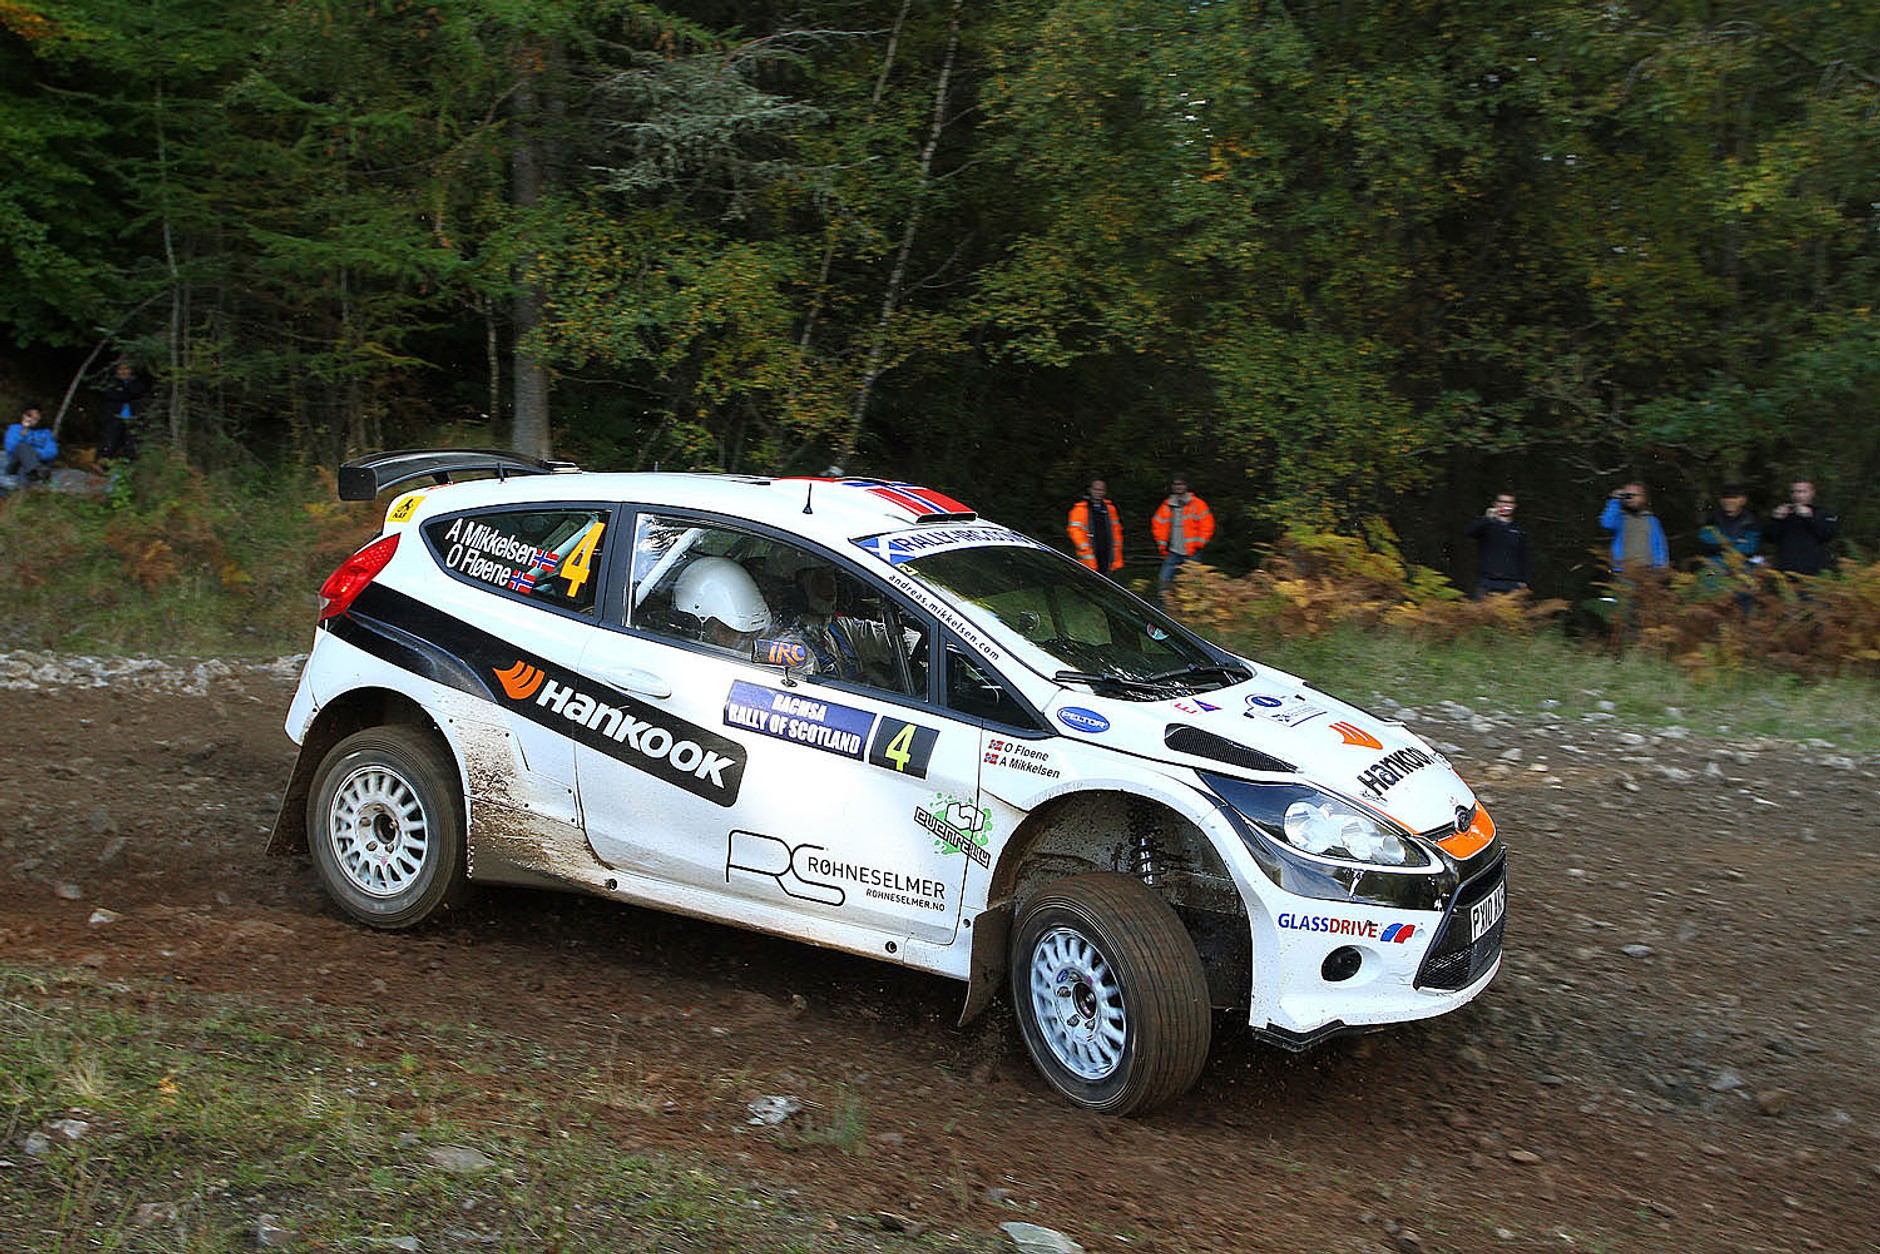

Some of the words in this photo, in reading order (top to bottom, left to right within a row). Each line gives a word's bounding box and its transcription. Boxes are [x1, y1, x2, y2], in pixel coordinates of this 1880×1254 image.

[445, 517, 464, 540] A
[460, 521, 538, 566] Mikkelsen
[559, 521, 606, 598] 4
[445, 543, 464, 568] O
[459, 548, 513, 587] Fløene
[888, 575, 1000, 661] andreas.mikkelsen.com
[768, 641, 805, 667] IRC
[771, 694, 828, 722] RACMSA
[1061, 711, 1106, 728] PELTOR
[727, 703, 770, 731] RALLY
[769, 713, 792, 736] OF
[788, 719, 863, 755] SCOTLAND
[885, 723, 917, 772] 4
[1004, 743, 1013, 753] O
[999, 757, 1007, 767] A
[1009, 758, 1061, 779] Mikkelsen
[1278, 913, 1379, 939] GLASSDRIVE
